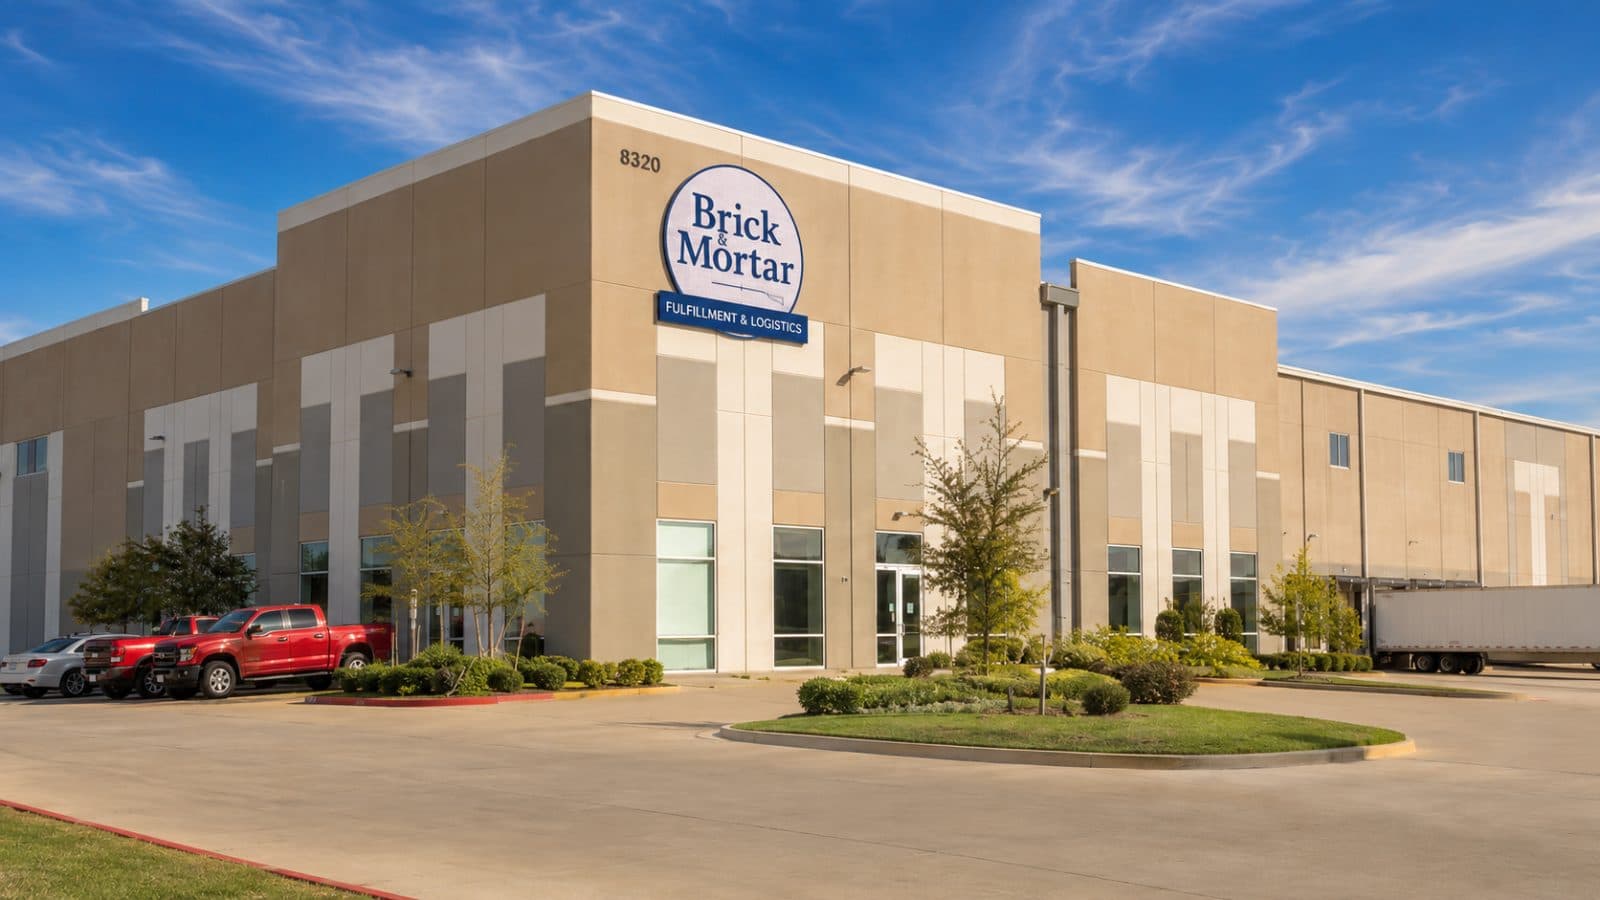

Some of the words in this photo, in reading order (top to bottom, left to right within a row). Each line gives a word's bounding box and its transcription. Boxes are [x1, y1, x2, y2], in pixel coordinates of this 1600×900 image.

[619, 149, 661, 173] 8320
[692, 191, 782, 246] Brick
[717, 233, 728, 246] &
[677, 229, 794, 285] Mortar
[665, 301, 738, 324] FULFILLMENT
[740, 314, 748, 326] &
[751, 315, 802, 334] LOGISTICS
